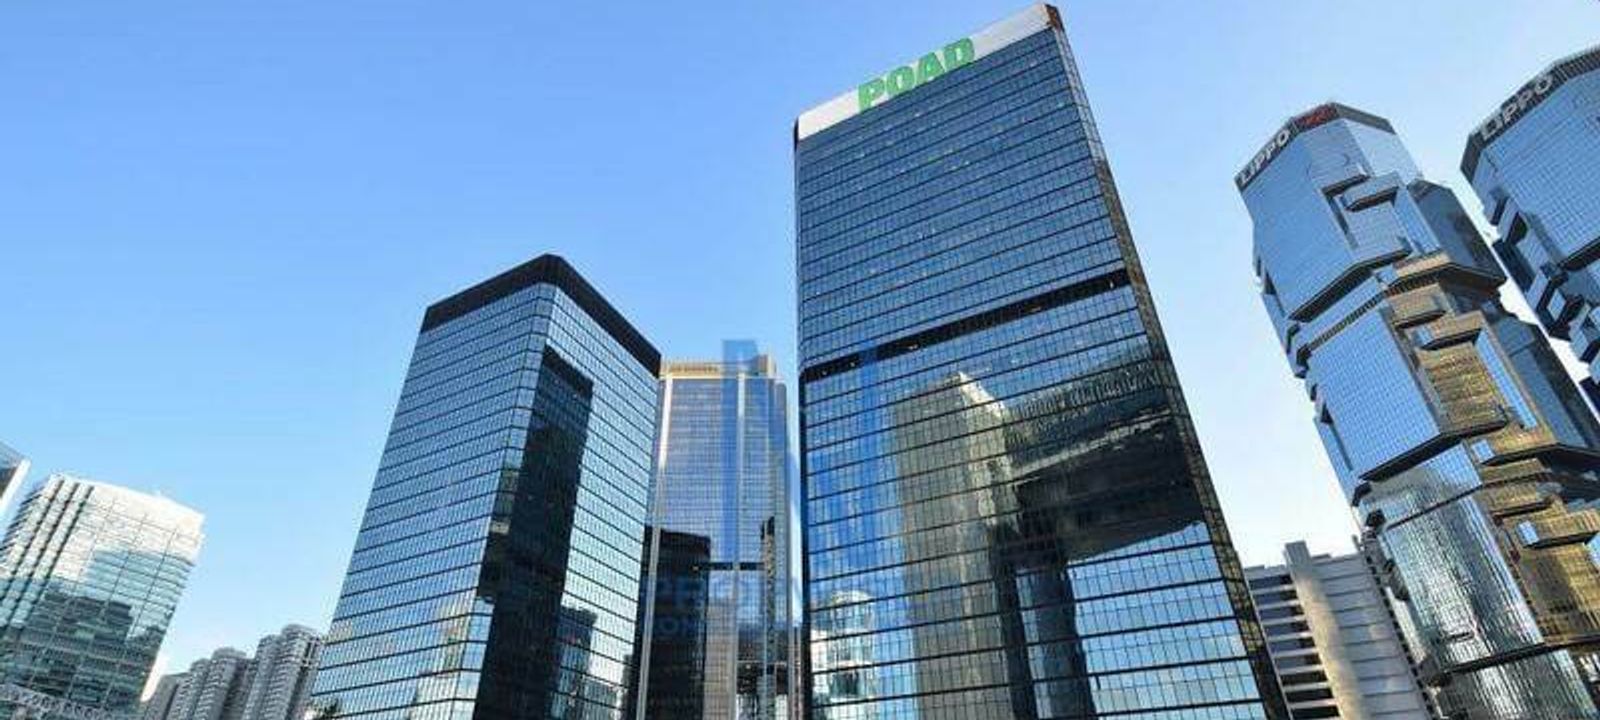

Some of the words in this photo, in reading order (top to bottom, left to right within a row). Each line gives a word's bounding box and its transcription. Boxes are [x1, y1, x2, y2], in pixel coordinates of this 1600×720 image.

[858, 38, 975, 111] POAD
[1480, 74, 1554, 141] LIPPO
[1240, 130, 1291, 184] LIPPO
